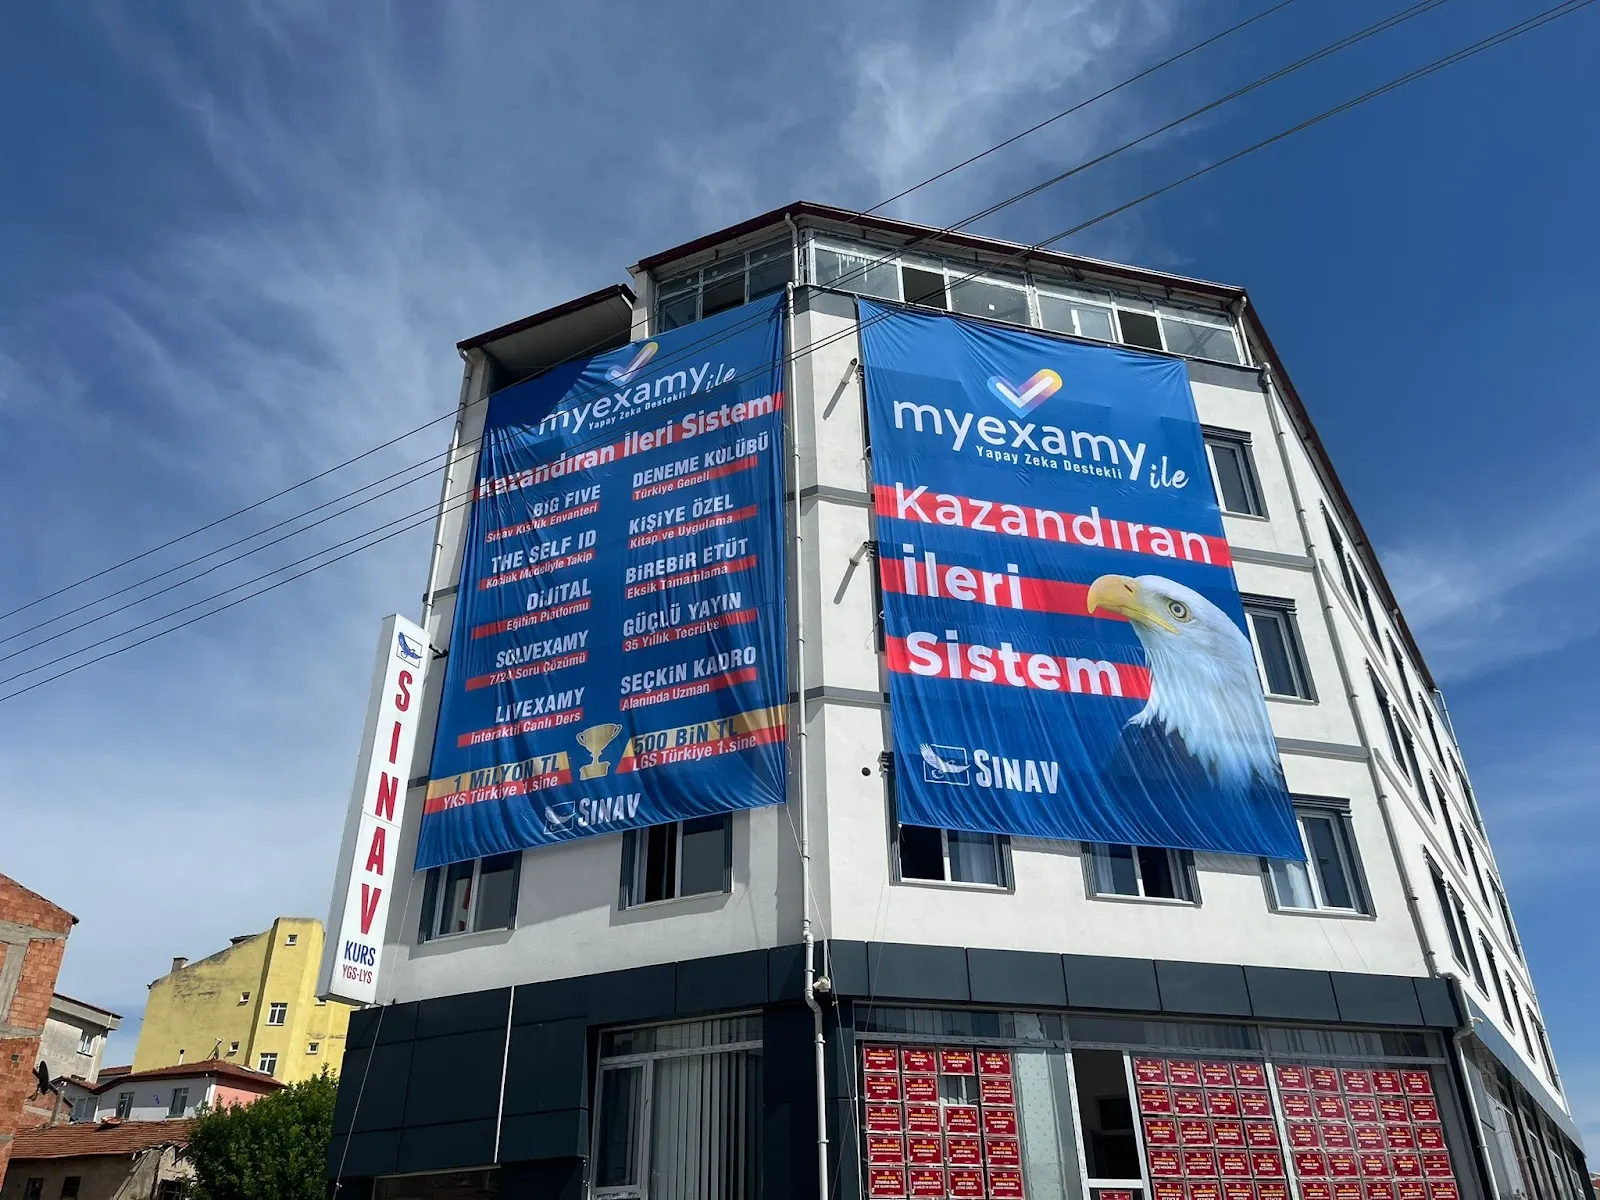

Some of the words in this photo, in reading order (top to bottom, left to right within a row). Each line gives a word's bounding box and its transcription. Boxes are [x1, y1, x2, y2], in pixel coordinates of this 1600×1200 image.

[705, 363, 737, 393] ile
[537, 361, 711, 436] myexamy
[588, 415, 617, 430] Yapay
[619, 406, 642, 420] Zeka
[644, 391, 686, 411] Destekli
[681, 393, 773, 439] Sistem
[893, 400, 1146, 481] myexamy
[632, 455, 699, 488] DENEME
[704, 430, 769, 468] KULÜBÜ
[976, 445, 1019, 465] Yapay
[1025, 446, 1058, 469] Zeka
[1063, 459, 1123, 480] Destekli
[1150, 456, 1190, 489] ile
[533, 496, 560, 518] BIG
[564, 484, 601, 509] FIVE
[634, 482, 674, 501] Türkiye
[677, 471, 710, 489] Geneli
[549, 503, 598, 525] Envanteri
[692, 494, 734, 518] ÖZEL
[895, 482, 1213, 565] Kazandıran
[629, 533, 658, 549] Kitap
[662, 529, 675, 540] ve
[678, 516, 733, 537] Uygulama
[703, 536, 749, 564] ETÜT
[491, 550, 523, 573] THE
[528, 536, 572, 564] SELF
[578, 529, 597, 550] ID
[519, 560, 565, 580] Modeliyle
[566, 551, 593, 569] Takip
[626, 583, 657, 599] Eksik
[660, 565, 729, 590] Tamamlama
[506, 616, 538, 631] Eğitim
[540, 601, 589, 622] Platformu
[623, 603, 681, 637] GÜÇLÜ
[688, 592, 742, 621] YAYIN
[495, 629, 590, 669] SOLVEXAMY
[624, 638, 639, 652] 35
[641, 633, 669, 648] Yıllık
[674, 619, 720, 640] Tecrübe
[515, 664, 540, 680] Soru
[543, 653, 587, 676] Çözümü
[693, 646, 757, 678] KADRO
[907, 629, 1123, 697] Sistem
[495, 686, 586, 723] LIVEXAMY
[621, 691, 670, 711] Alanında
[672, 683, 710, 700] Uzman
[522, 716, 552, 733] Canlı
[555, 711, 581, 727] Ders
[634, 732, 668, 756] 500
[717, 718, 738, 739] TL
[632, 752, 657, 772] LGS
[661, 745, 713, 765] Türkiye
[717, 735, 756, 754] 1.sine
[454, 777, 462, 793] 1
[541, 754, 560, 773] TL
[973, 749, 1059, 794] SINAV
[360, 669, 413, 935] SINAV
[443, 792, 466, 811] YKS
[470, 781, 517, 802] Türkiye
[522, 775, 558, 795] 1.sine
[577, 792, 641, 828] SINAV
[344, 940, 376, 967] KURS
[342, 964, 373, 984] YGS-LYS
